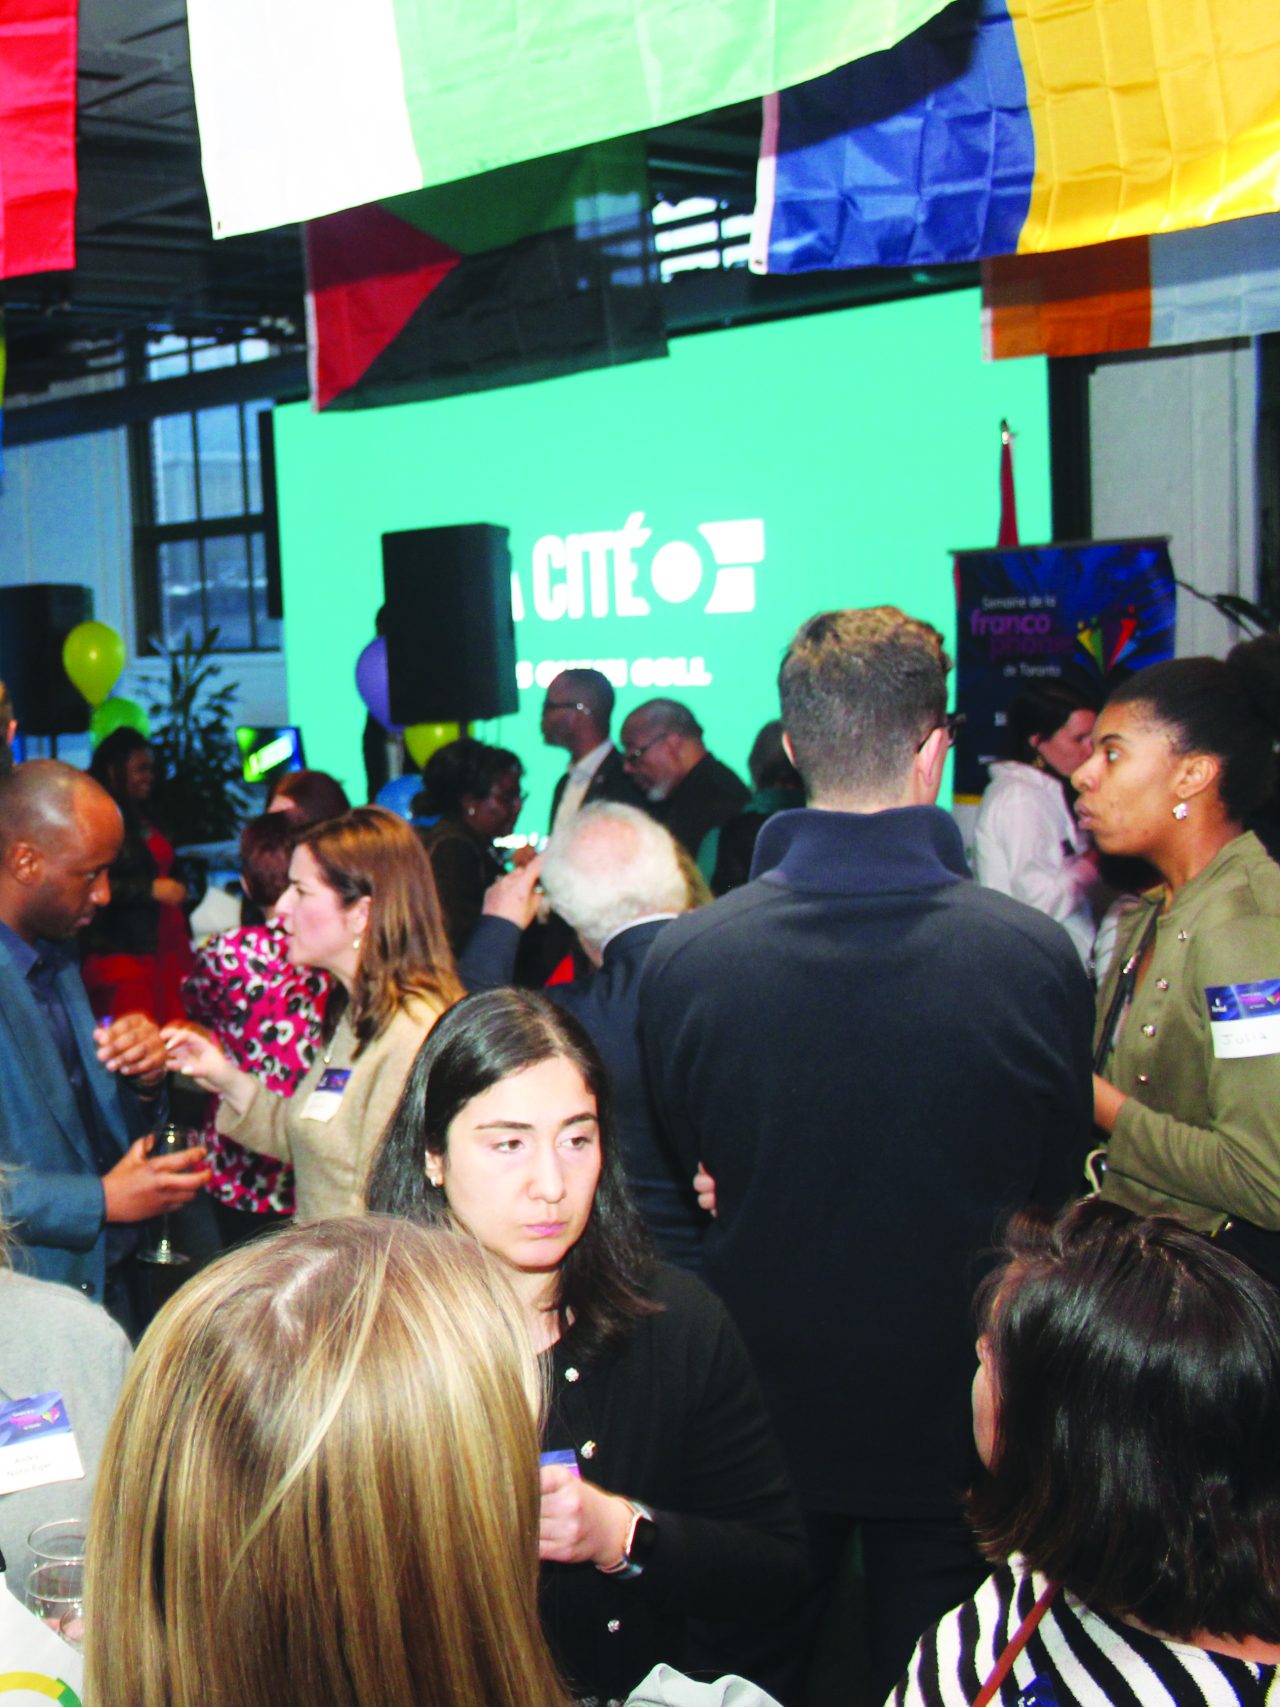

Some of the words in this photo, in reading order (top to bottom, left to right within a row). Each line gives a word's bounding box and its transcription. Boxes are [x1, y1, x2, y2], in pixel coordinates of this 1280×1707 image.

[532, 511, 652, 621] CITÉ
[1028, 595, 1043, 609] de
[971, 608, 1052, 636] franco
[1019, 662, 1062, 678] Toronto
